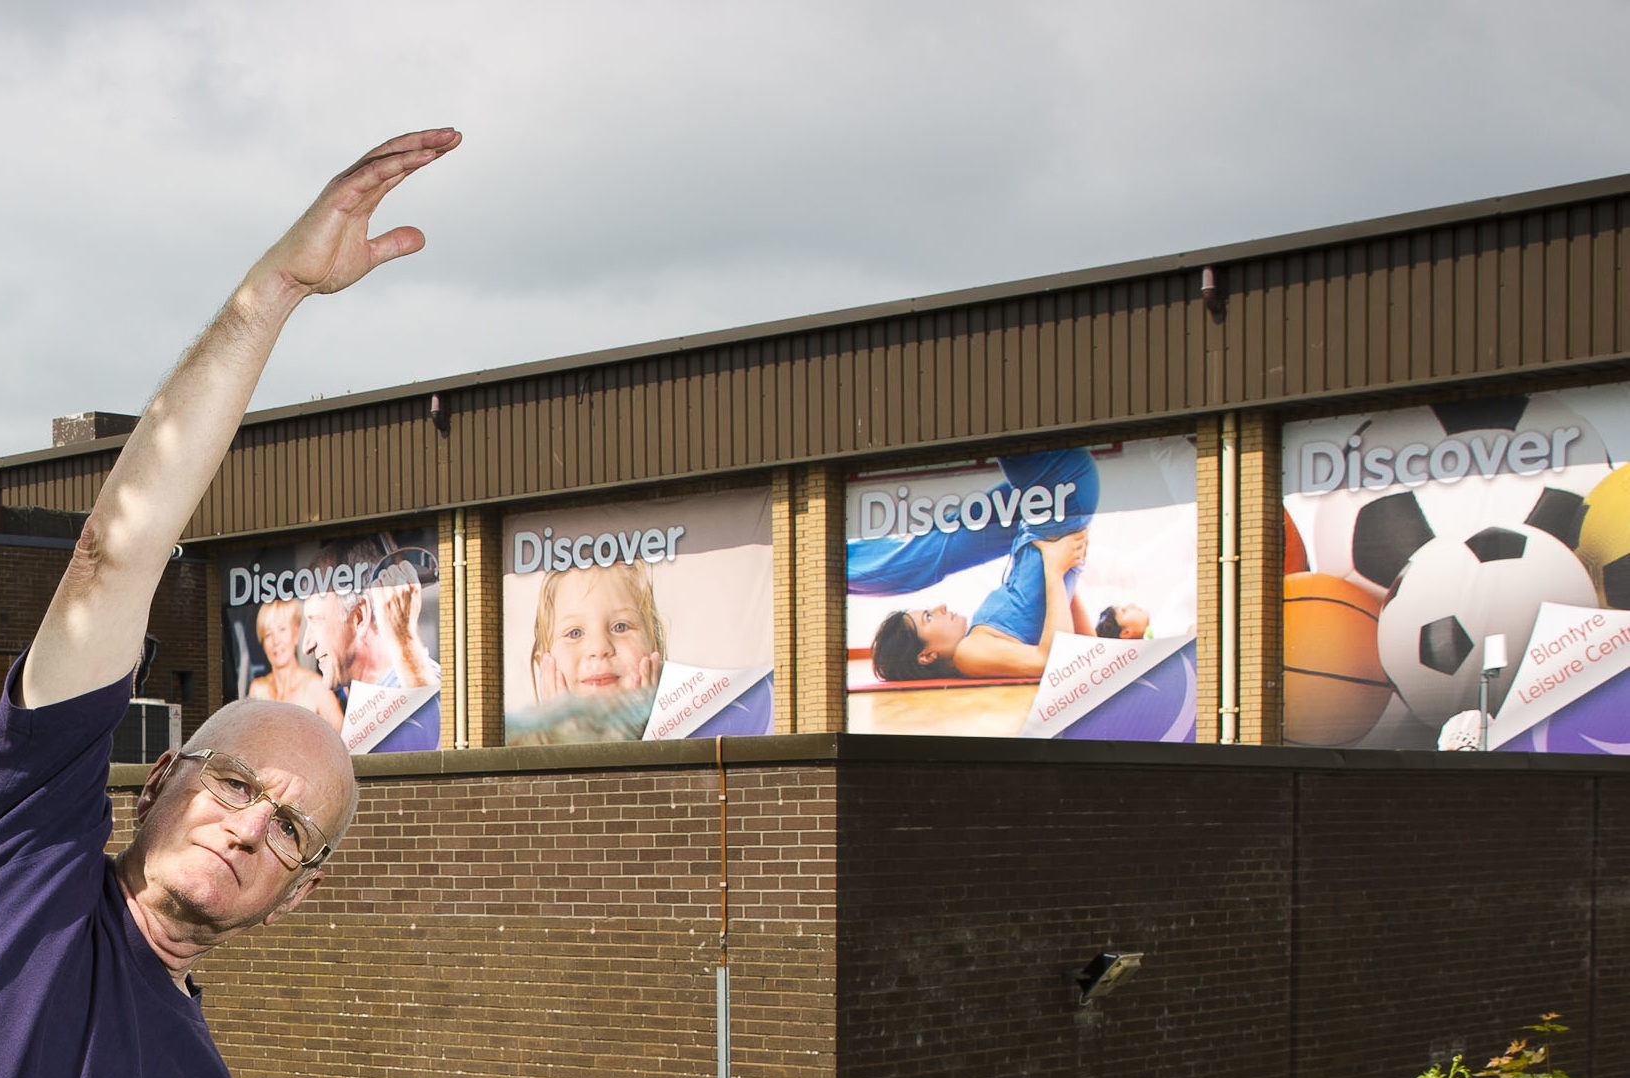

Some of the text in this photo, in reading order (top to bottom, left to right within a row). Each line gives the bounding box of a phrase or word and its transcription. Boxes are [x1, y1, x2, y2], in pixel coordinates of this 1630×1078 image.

[1300, 426, 1581, 497] Discover
[860, 482, 1076, 540] Discover
[514, 527, 685, 574] Discover
[229, 562, 369, 606] Discover
[1530, 614, 1606, 665] Blantyre
[1038, 648, 1139, 722] Leisure Centre
[1048, 643, 1106, 688] Blantyre
[1518, 660, 1585, 704] Leisure
[348, 690, 386, 726] Blantyre
[651, 677, 730, 741] Leisure Centre
[658, 671, 706, 711] Blantyre
[348, 695, 408, 751] eisure Centre
